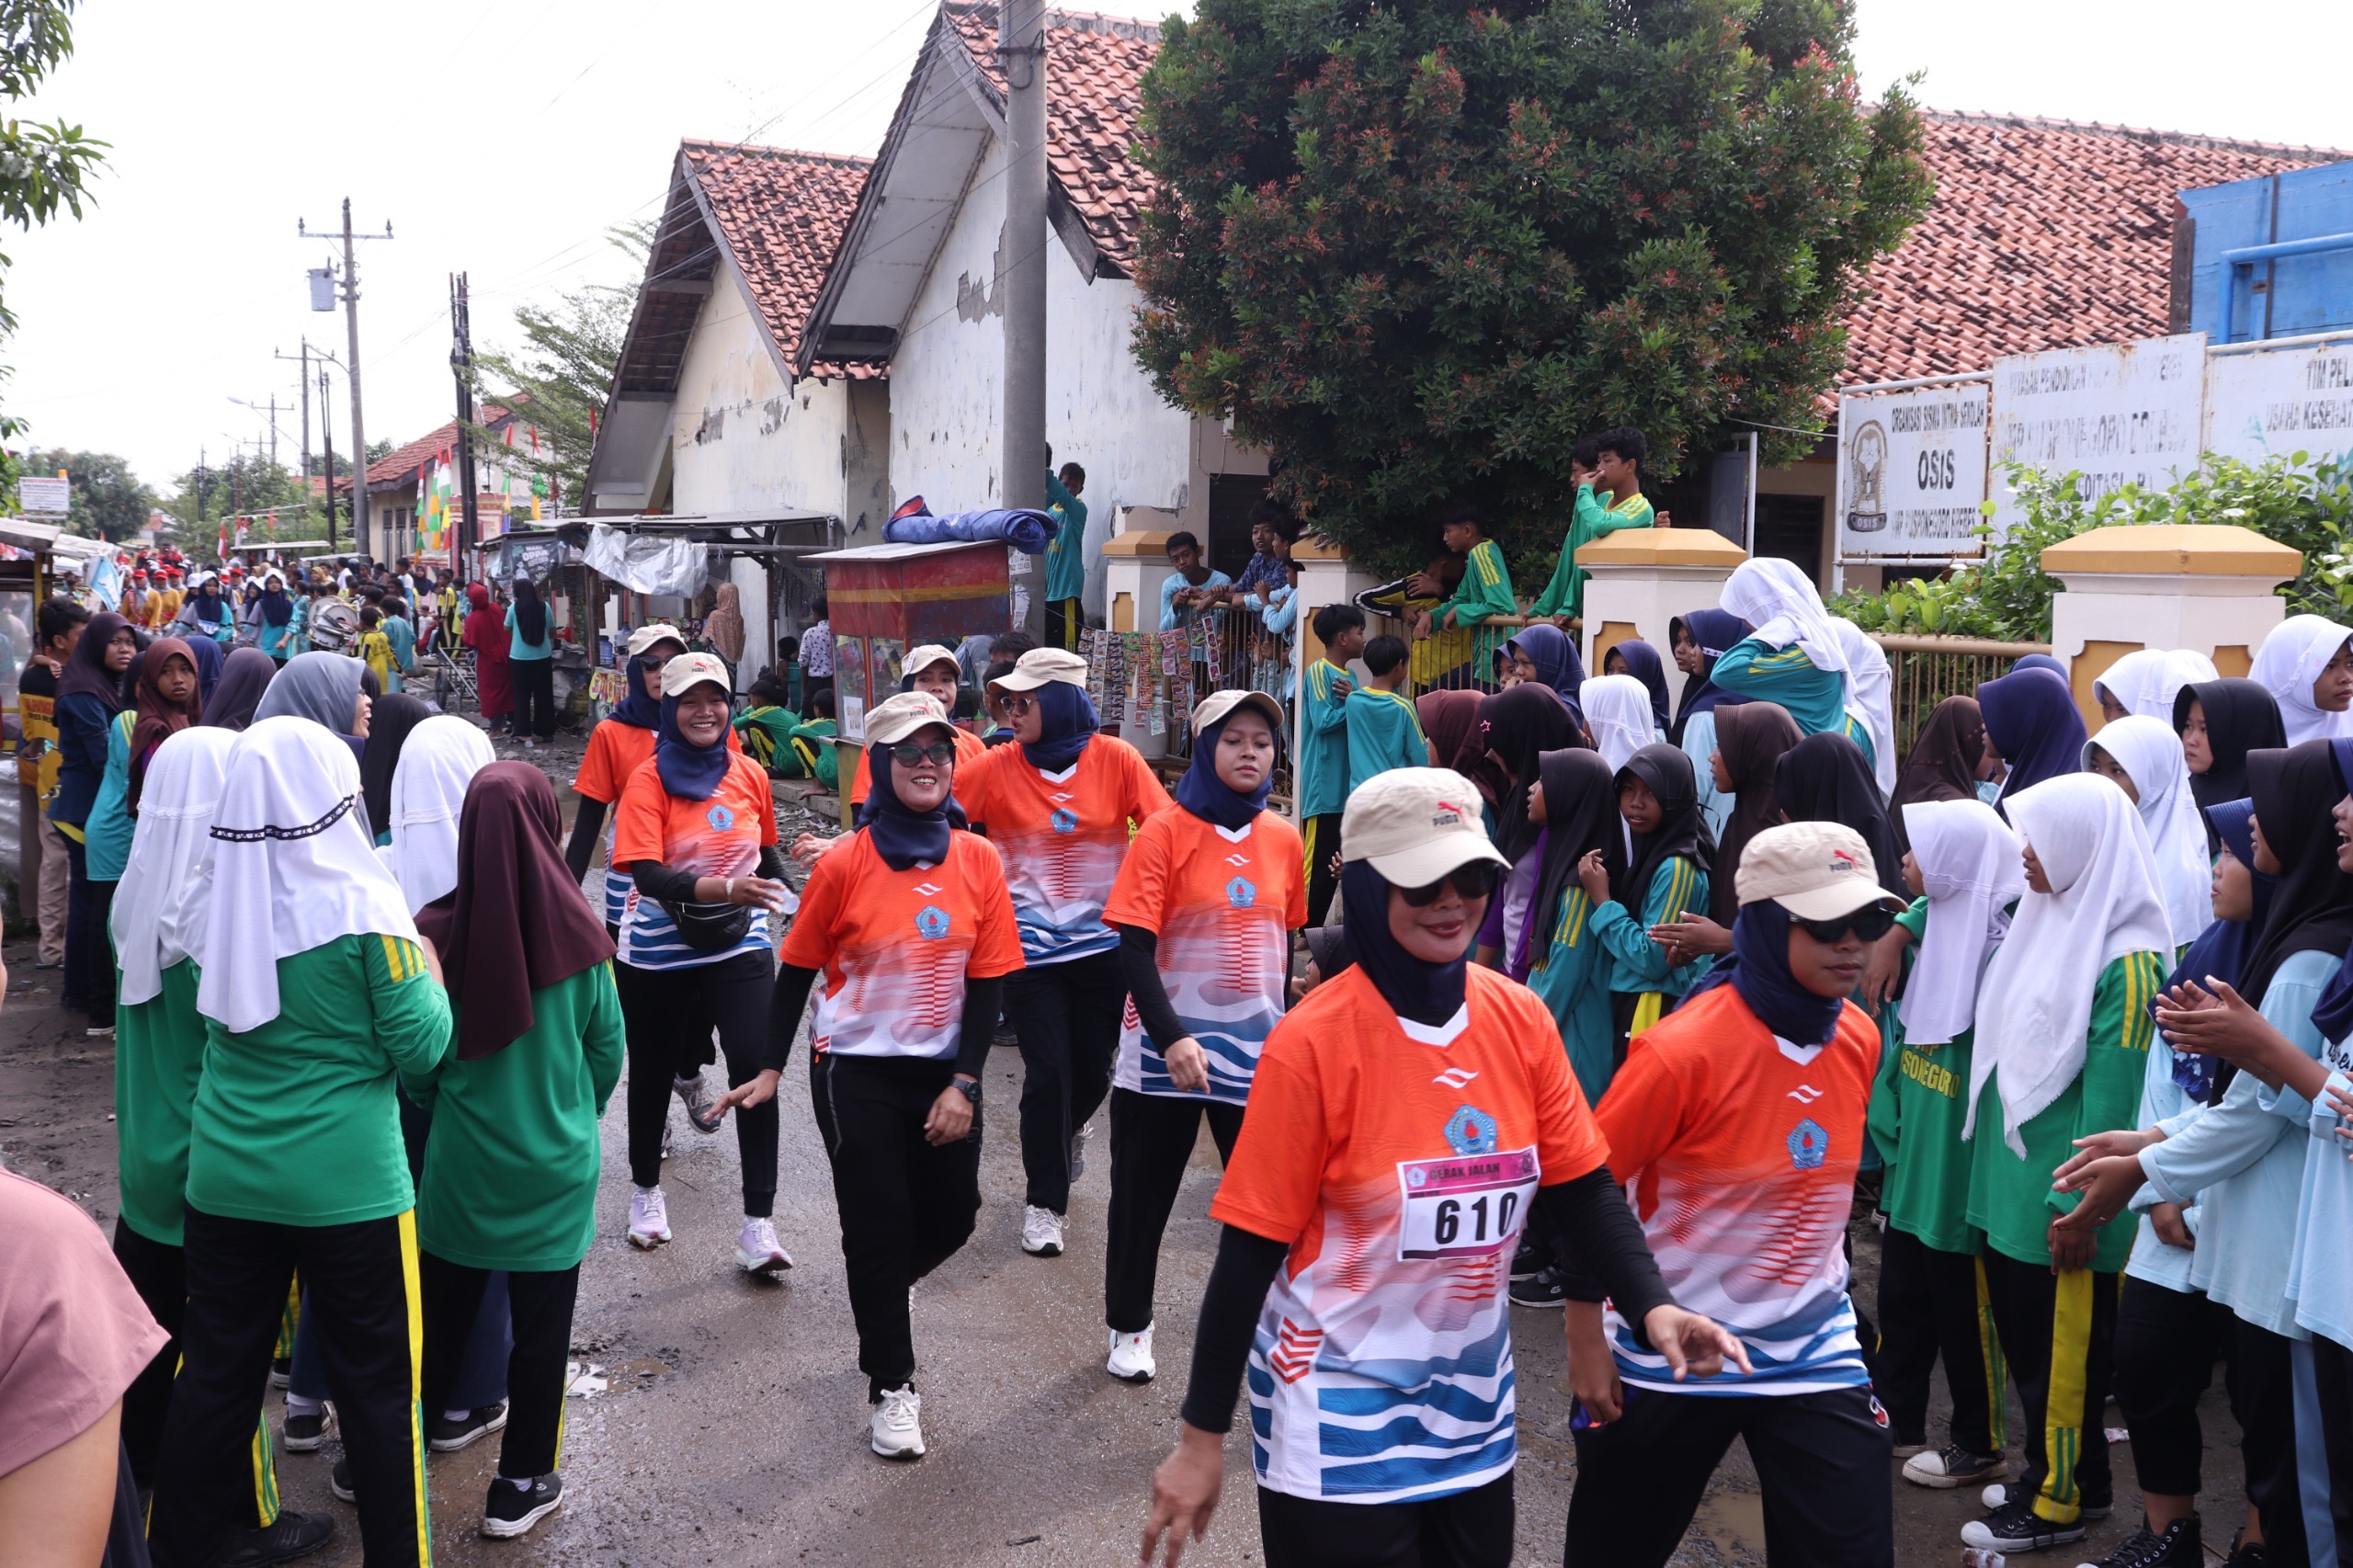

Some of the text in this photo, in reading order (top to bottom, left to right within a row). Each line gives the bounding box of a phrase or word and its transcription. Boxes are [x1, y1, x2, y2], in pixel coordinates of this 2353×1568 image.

[2305, 356, 2353, 390] TIM PEL
[1892, 400, 1984, 433] ORGANISASI SISWA INTRA SEKOLAH
[1917, 449, 1955, 490] OSIS
[1858, 517, 1878, 528] OSIS
[1433, 814, 1459, 826] PUMA
[1428, 1165, 1466, 1181] GERAK
[1468, 1162, 1500, 1177] JALAN
[1435, 1191, 1518, 1245] 610
